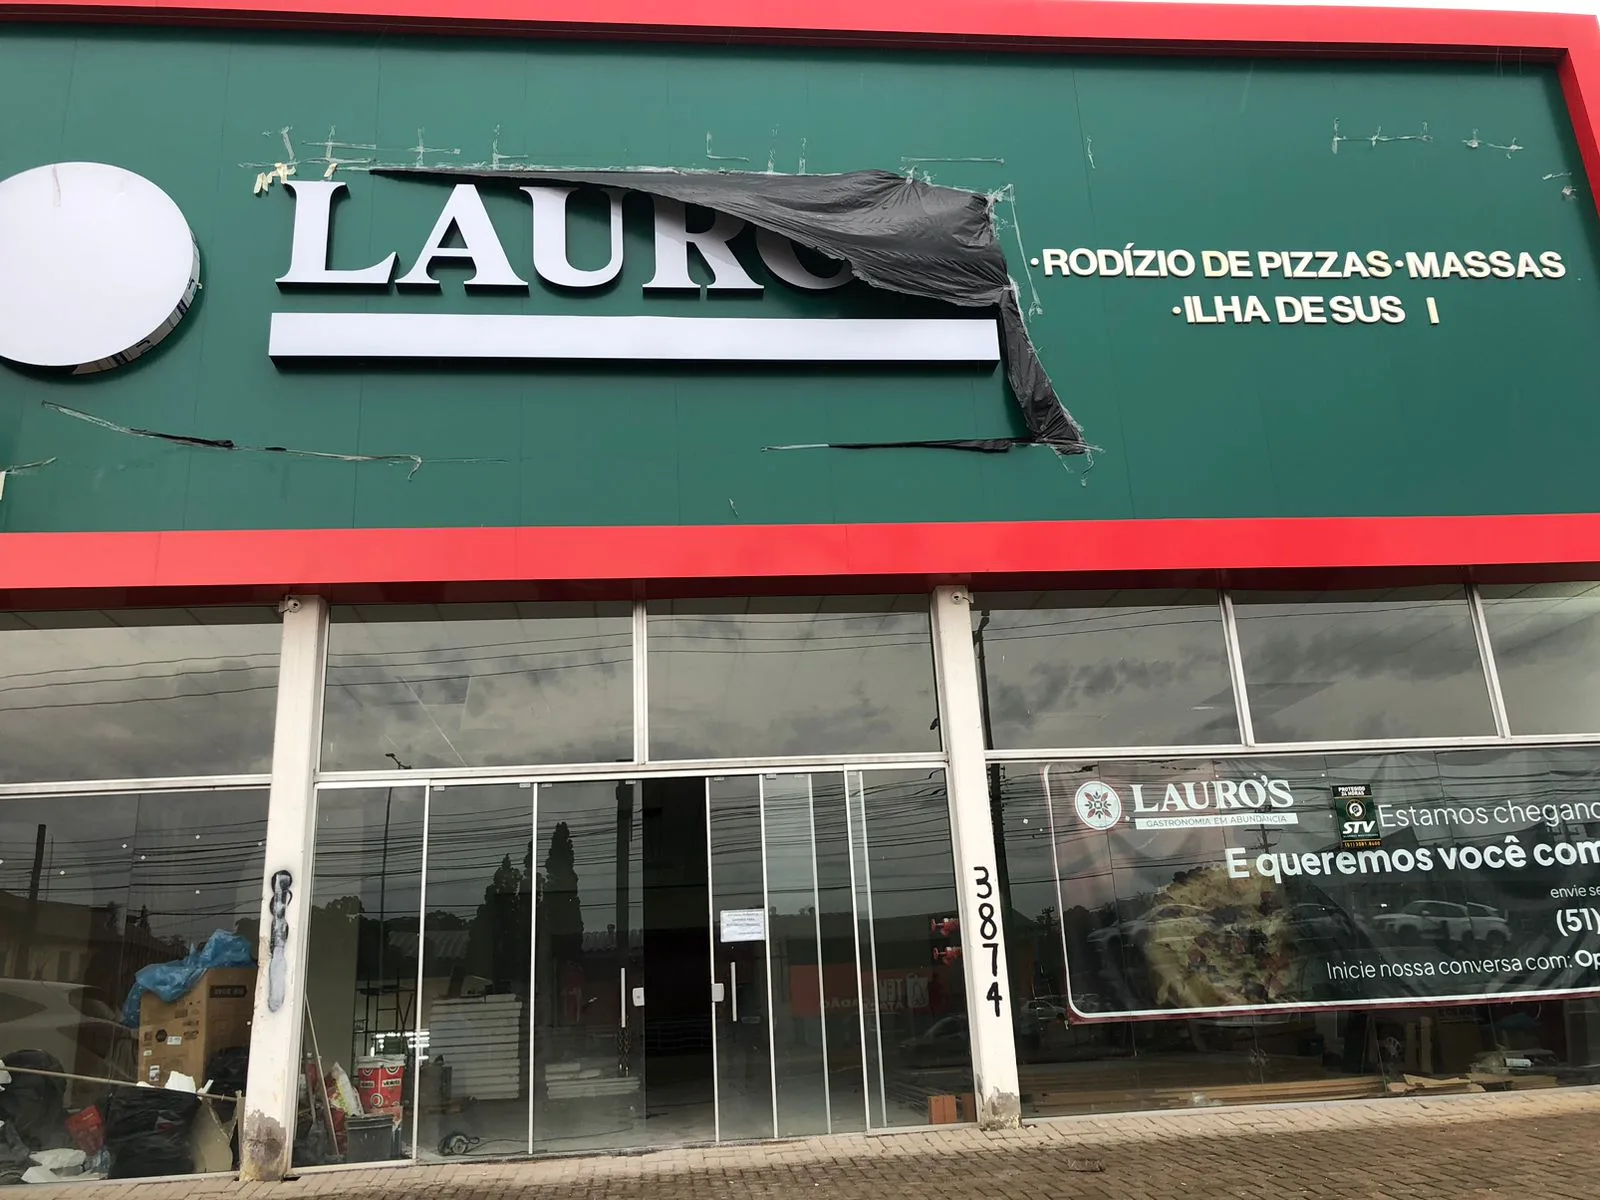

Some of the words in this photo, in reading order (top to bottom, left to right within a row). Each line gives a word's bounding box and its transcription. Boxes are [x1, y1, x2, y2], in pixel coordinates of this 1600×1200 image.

[1201, 250, 1254, 279] DE
[1274, 296, 1328, 325] DE
[1129, 774, 1294, 813] LAURO'S
[1146, 817, 1212, 828] GASTRONOMIA
[1213, 816, 1228, 826] EM
[1342, 820, 1376, 834] STV
[1377, 804, 1489, 828] Estamos
[1224, 847, 1250, 879] E
[1255, 847, 1434, 884] queremos
[1437, 835, 1527, 870] você
[1550, 884, 1586, 899] envie
[1556, 907, 1600, 937] (51)
[973, 866, 1003, 1017] 3874
[1327, 960, 1376, 980] Inicie
[1380, 961, 1436, 978] nossa
[1438, 957, 1523, 976] conversa
[1525, 953, 1573, 971] com:
